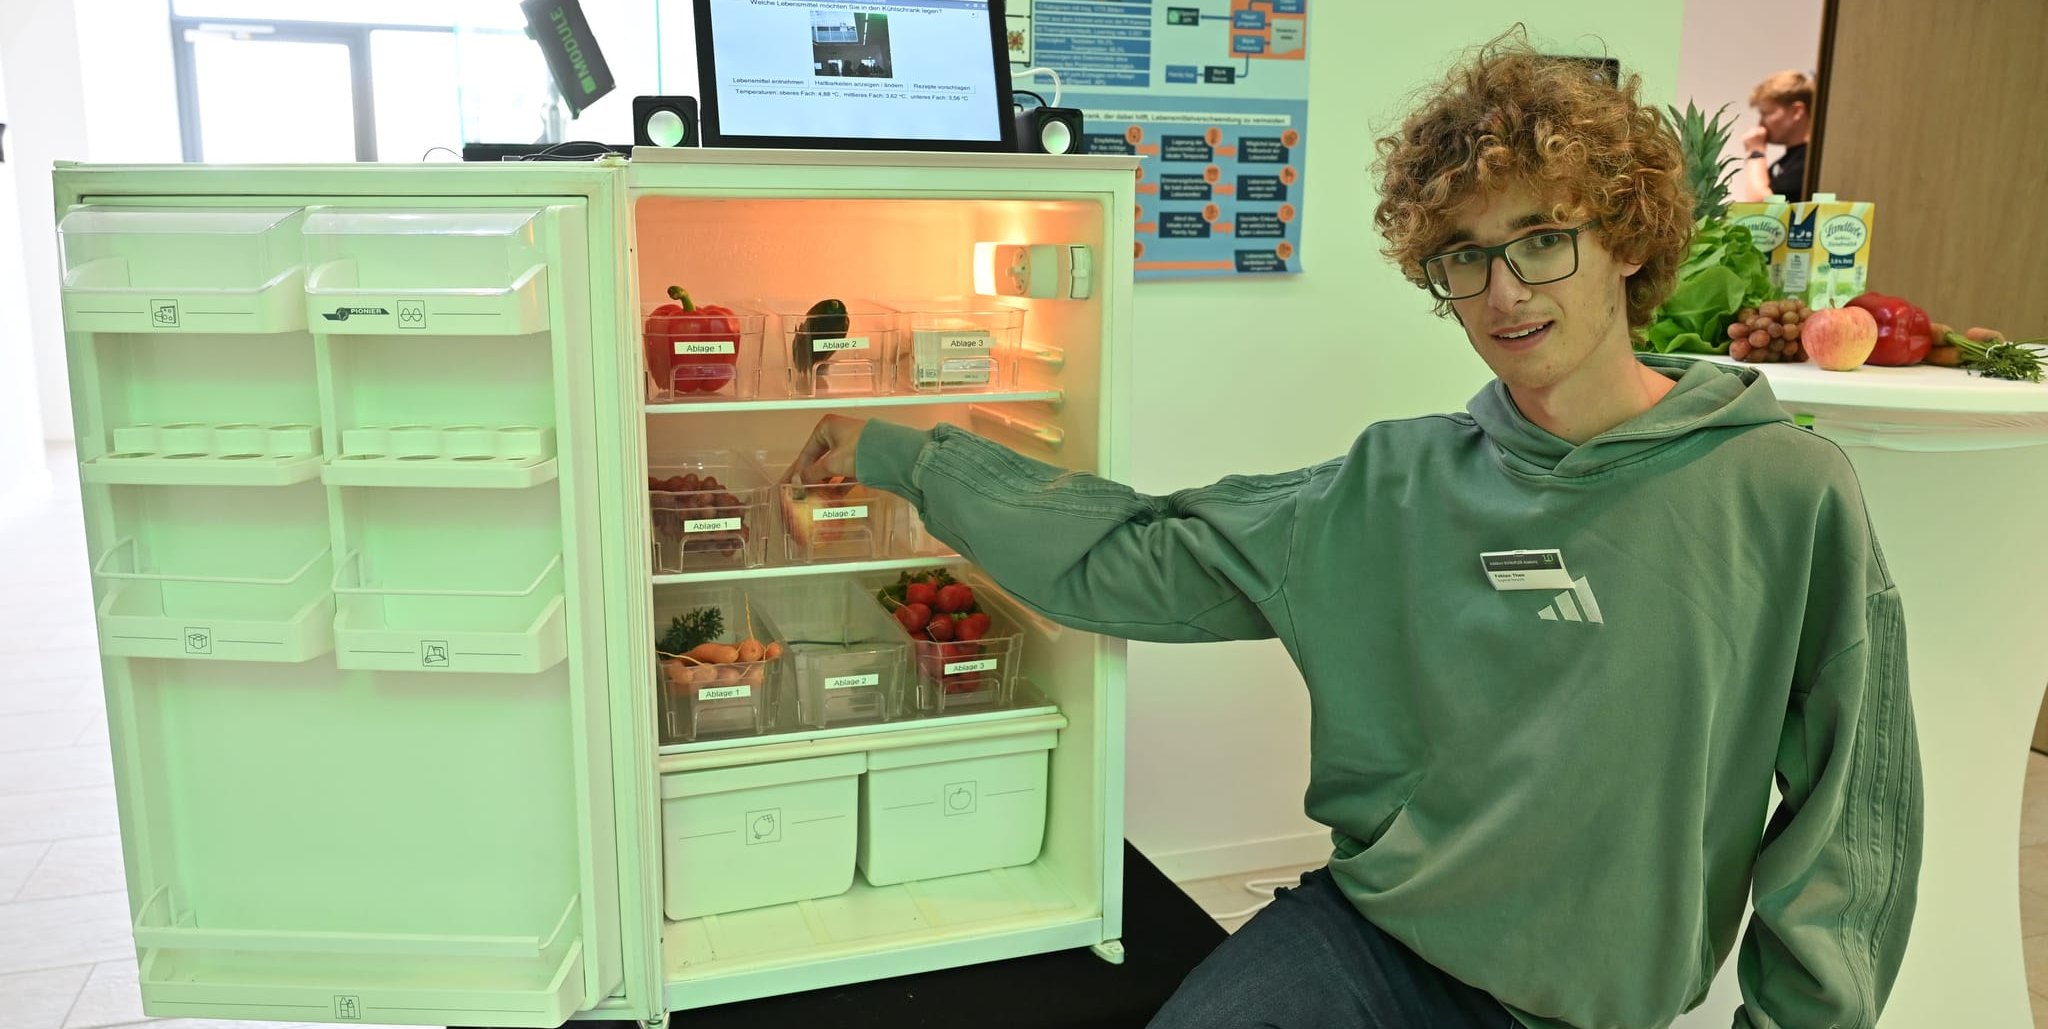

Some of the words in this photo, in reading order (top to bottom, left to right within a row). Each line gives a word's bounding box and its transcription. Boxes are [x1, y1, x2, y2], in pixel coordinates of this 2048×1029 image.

[777, 0, 818, 8] Lebensmittel
[882, 6, 920, 14] Kühlschrank
[550, 6, 590, 79] MODULE
[1825, 221, 1862, 238] Landliebe
[822, 341, 850, 349] Ablage
[851, 340, 857, 348] 2
[950, 339, 977, 348] Ablage
[978, 339, 984, 347] 3
[686, 344, 715, 353] Ablage
[822, 510, 849, 518] Ablage
[850, 509, 856, 517] 2
[833, 678, 860, 686] Ablage
[705, 690, 733, 698] Ablage
